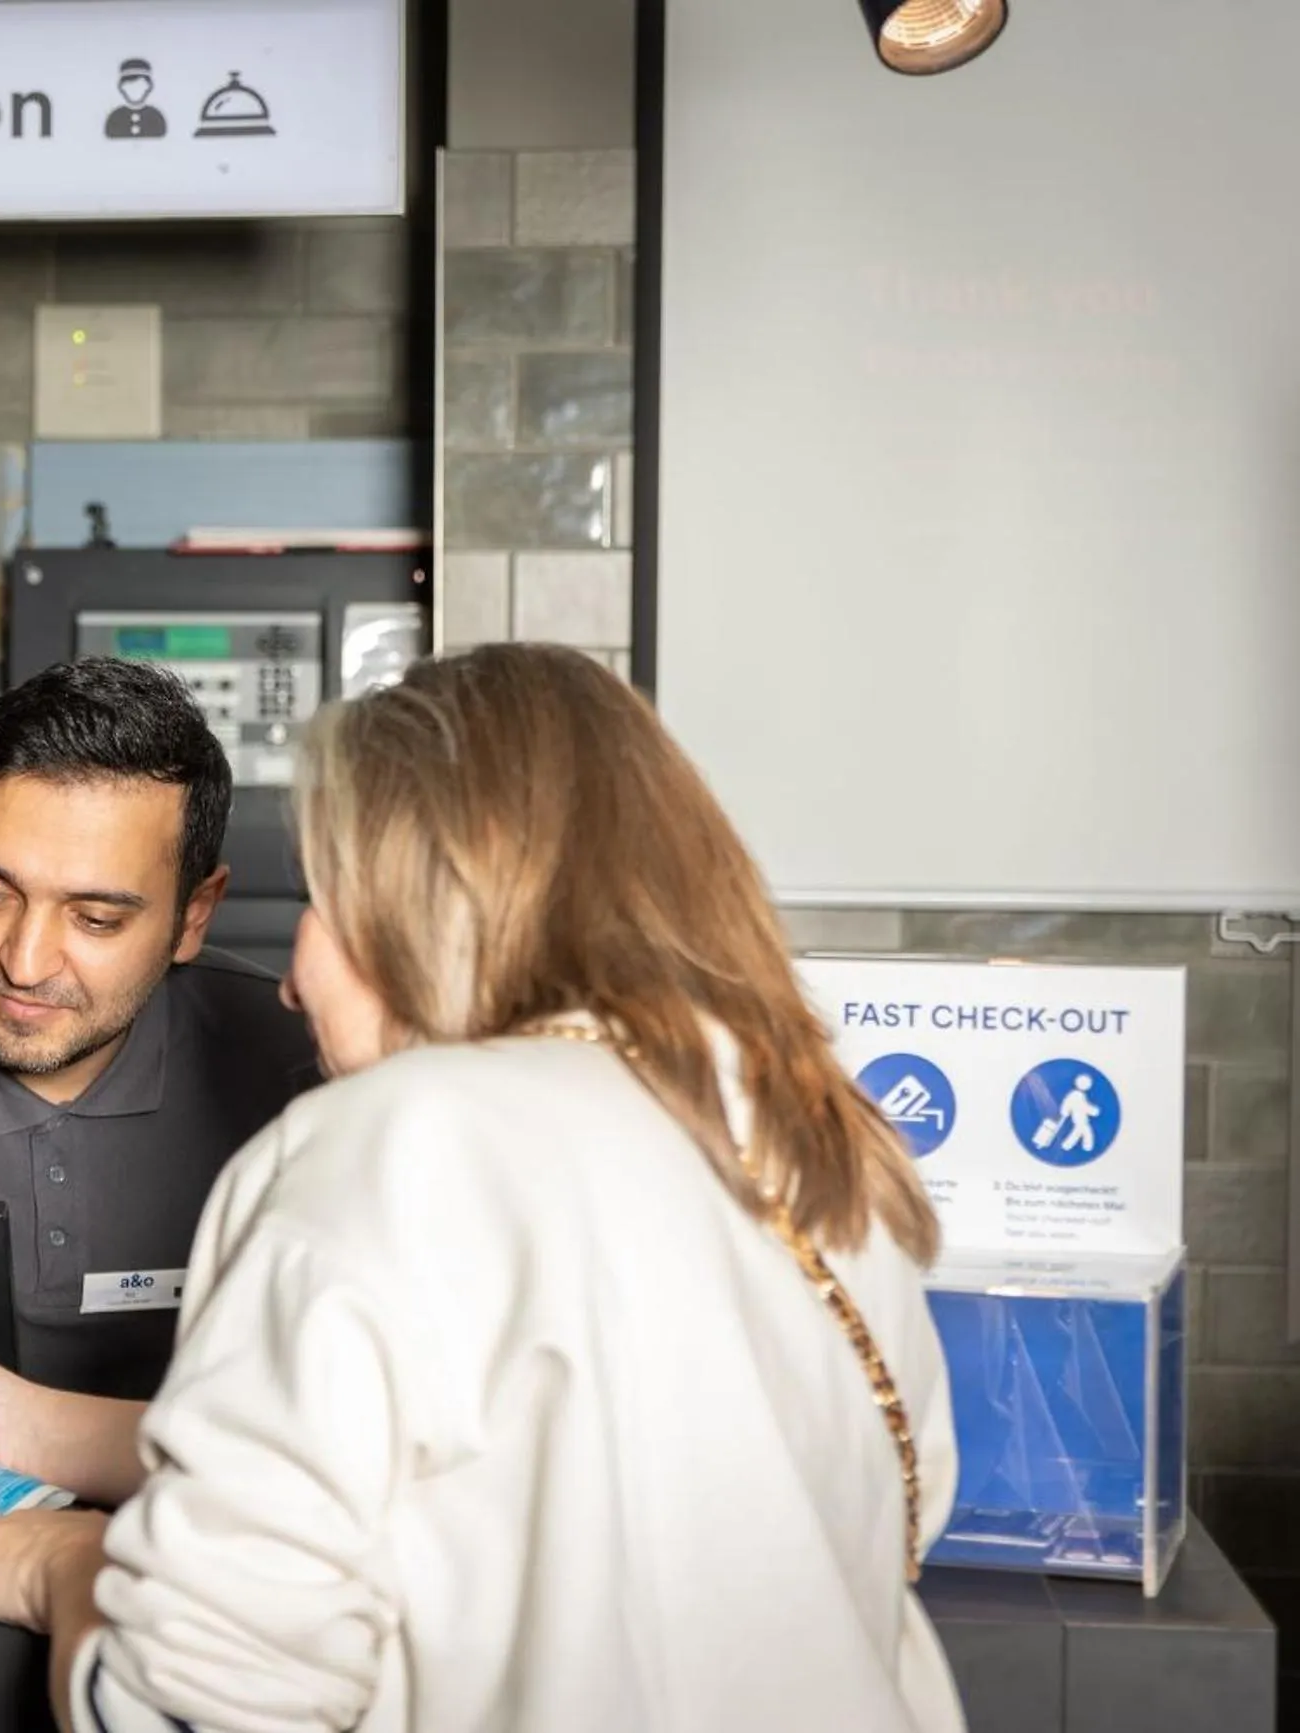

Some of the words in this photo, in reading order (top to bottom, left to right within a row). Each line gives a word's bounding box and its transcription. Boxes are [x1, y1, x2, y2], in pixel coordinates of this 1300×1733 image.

[843, 1002, 921, 1028] FAST
[931, 1004, 1130, 1034] CHECK-OUT
[120, 1273, 155, 1289] a&o
